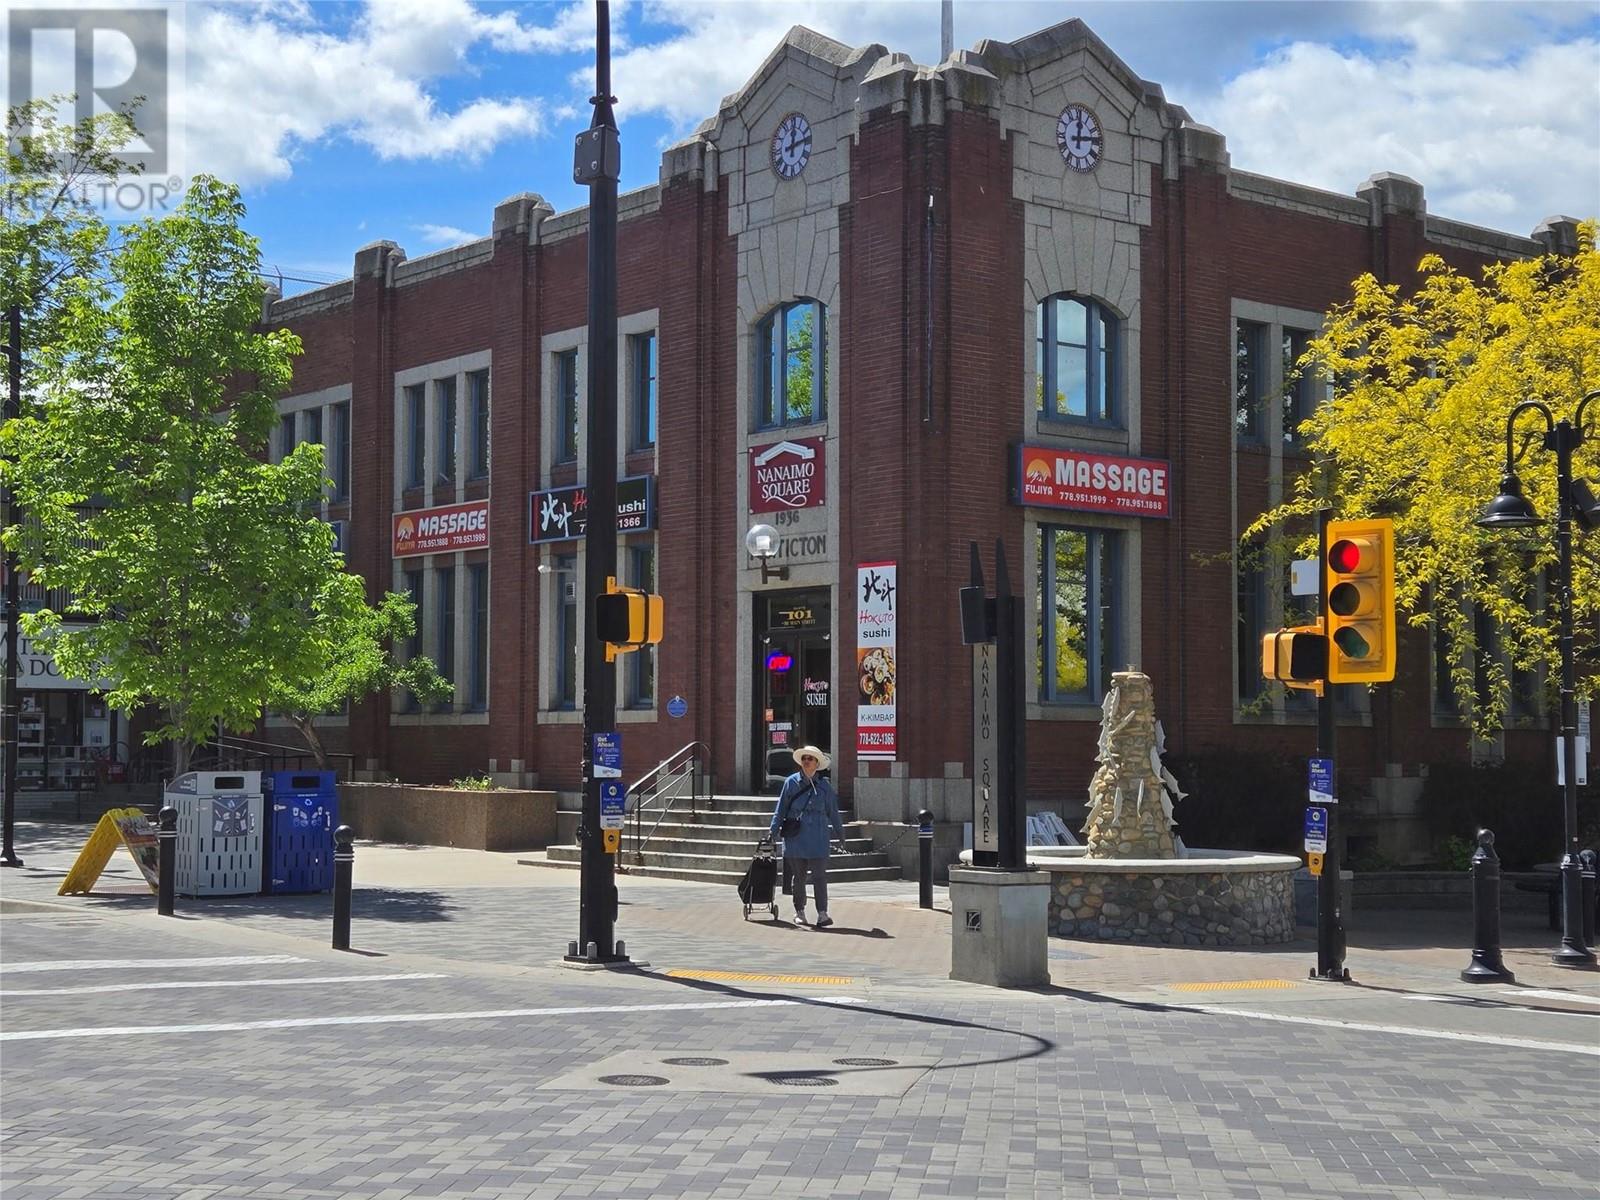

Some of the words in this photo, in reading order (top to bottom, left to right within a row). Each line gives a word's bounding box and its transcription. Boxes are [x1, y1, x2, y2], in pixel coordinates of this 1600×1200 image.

[757, 462, 815, 484] NANAIMO
[1055, 458, 1166, 496] MASSAGE
[761, 479, 811, 504] SQUARE
[1025, 484, 1053, 496] FUJIYA
[1059, 491, 1107, 505] 778.951.1999
[418, 509, 487, 537] MASSAGE
[863, 627, 891, 639] sushi
[806, 693, 827, 706] SUSHI
[981, 645, 990, 740] NANAIMO
